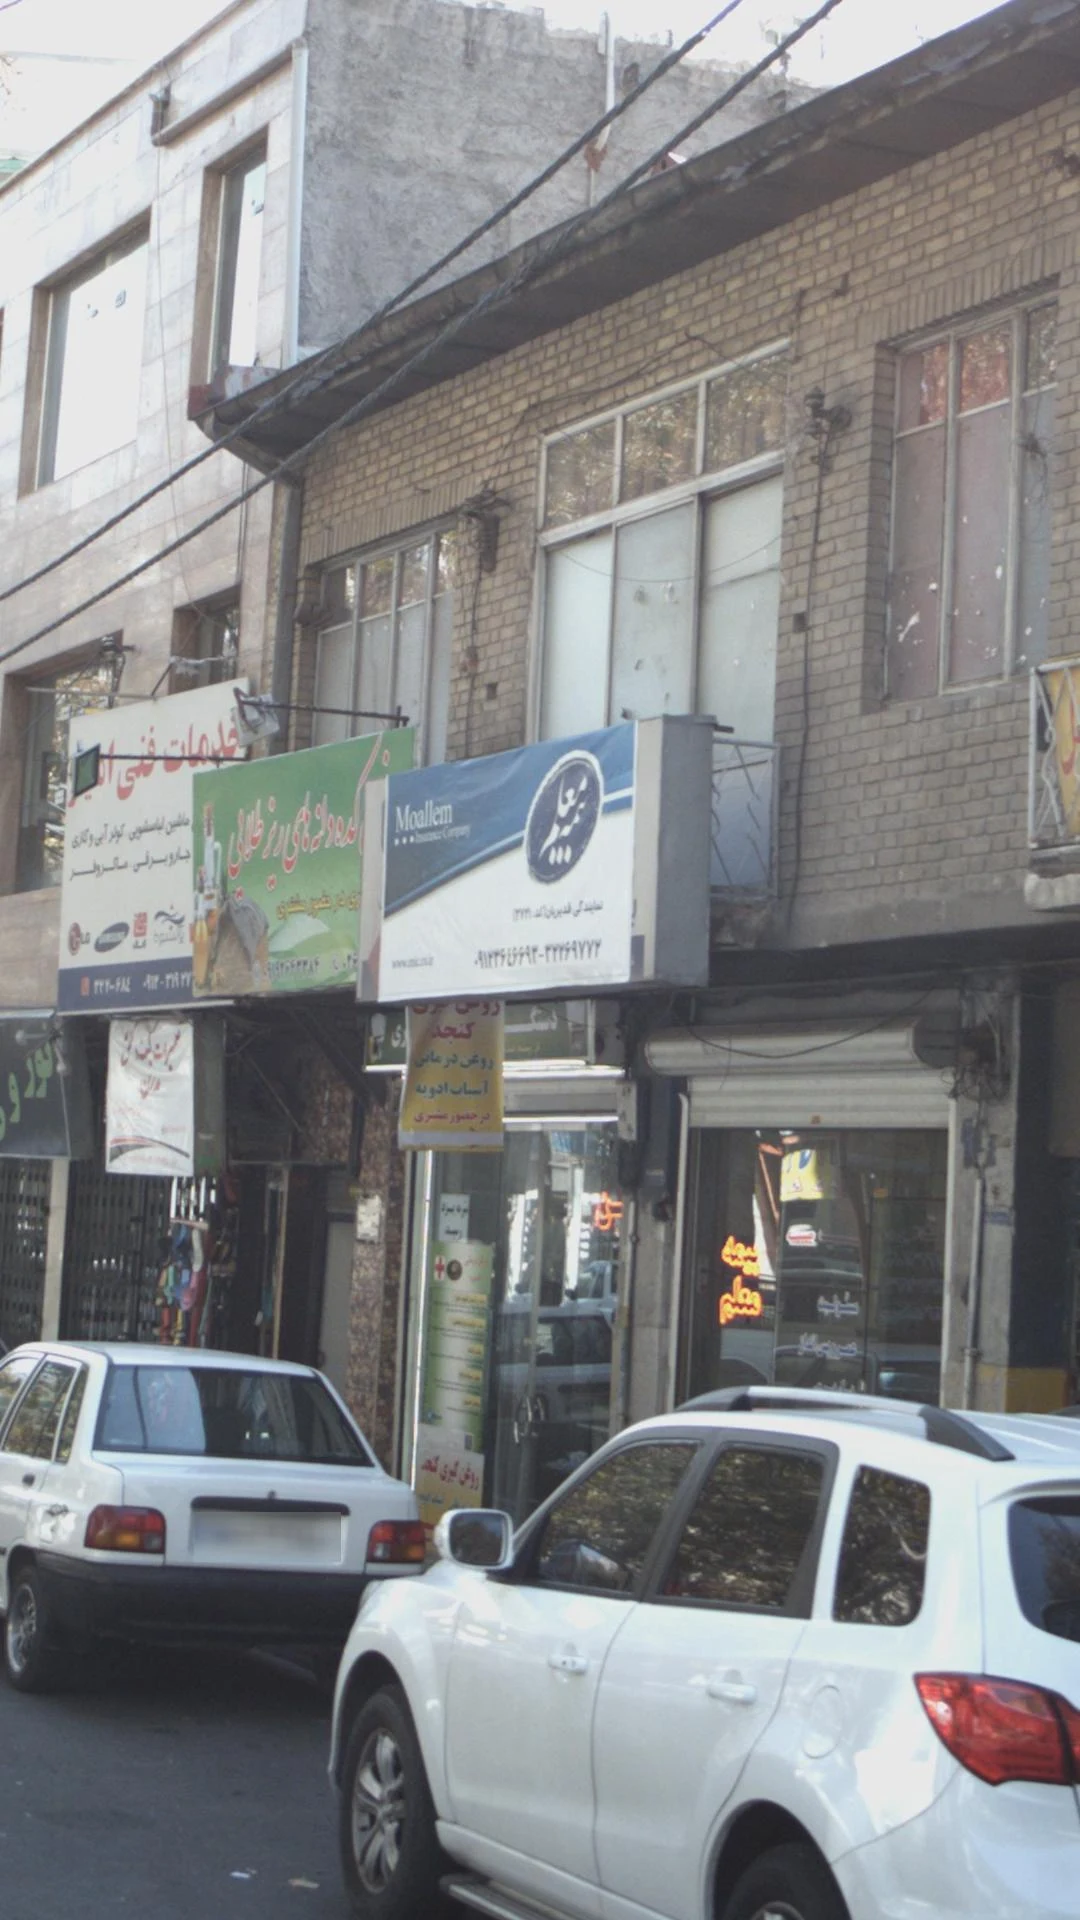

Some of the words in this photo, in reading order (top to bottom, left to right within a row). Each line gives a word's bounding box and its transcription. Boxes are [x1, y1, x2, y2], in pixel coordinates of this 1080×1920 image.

[116, 725, 156, 801] فنی
[395, 799, 453, 833] Moallem
[431, 1021, 477, 1045] کنجد
[460, 1052, 494, 1070] روغن
